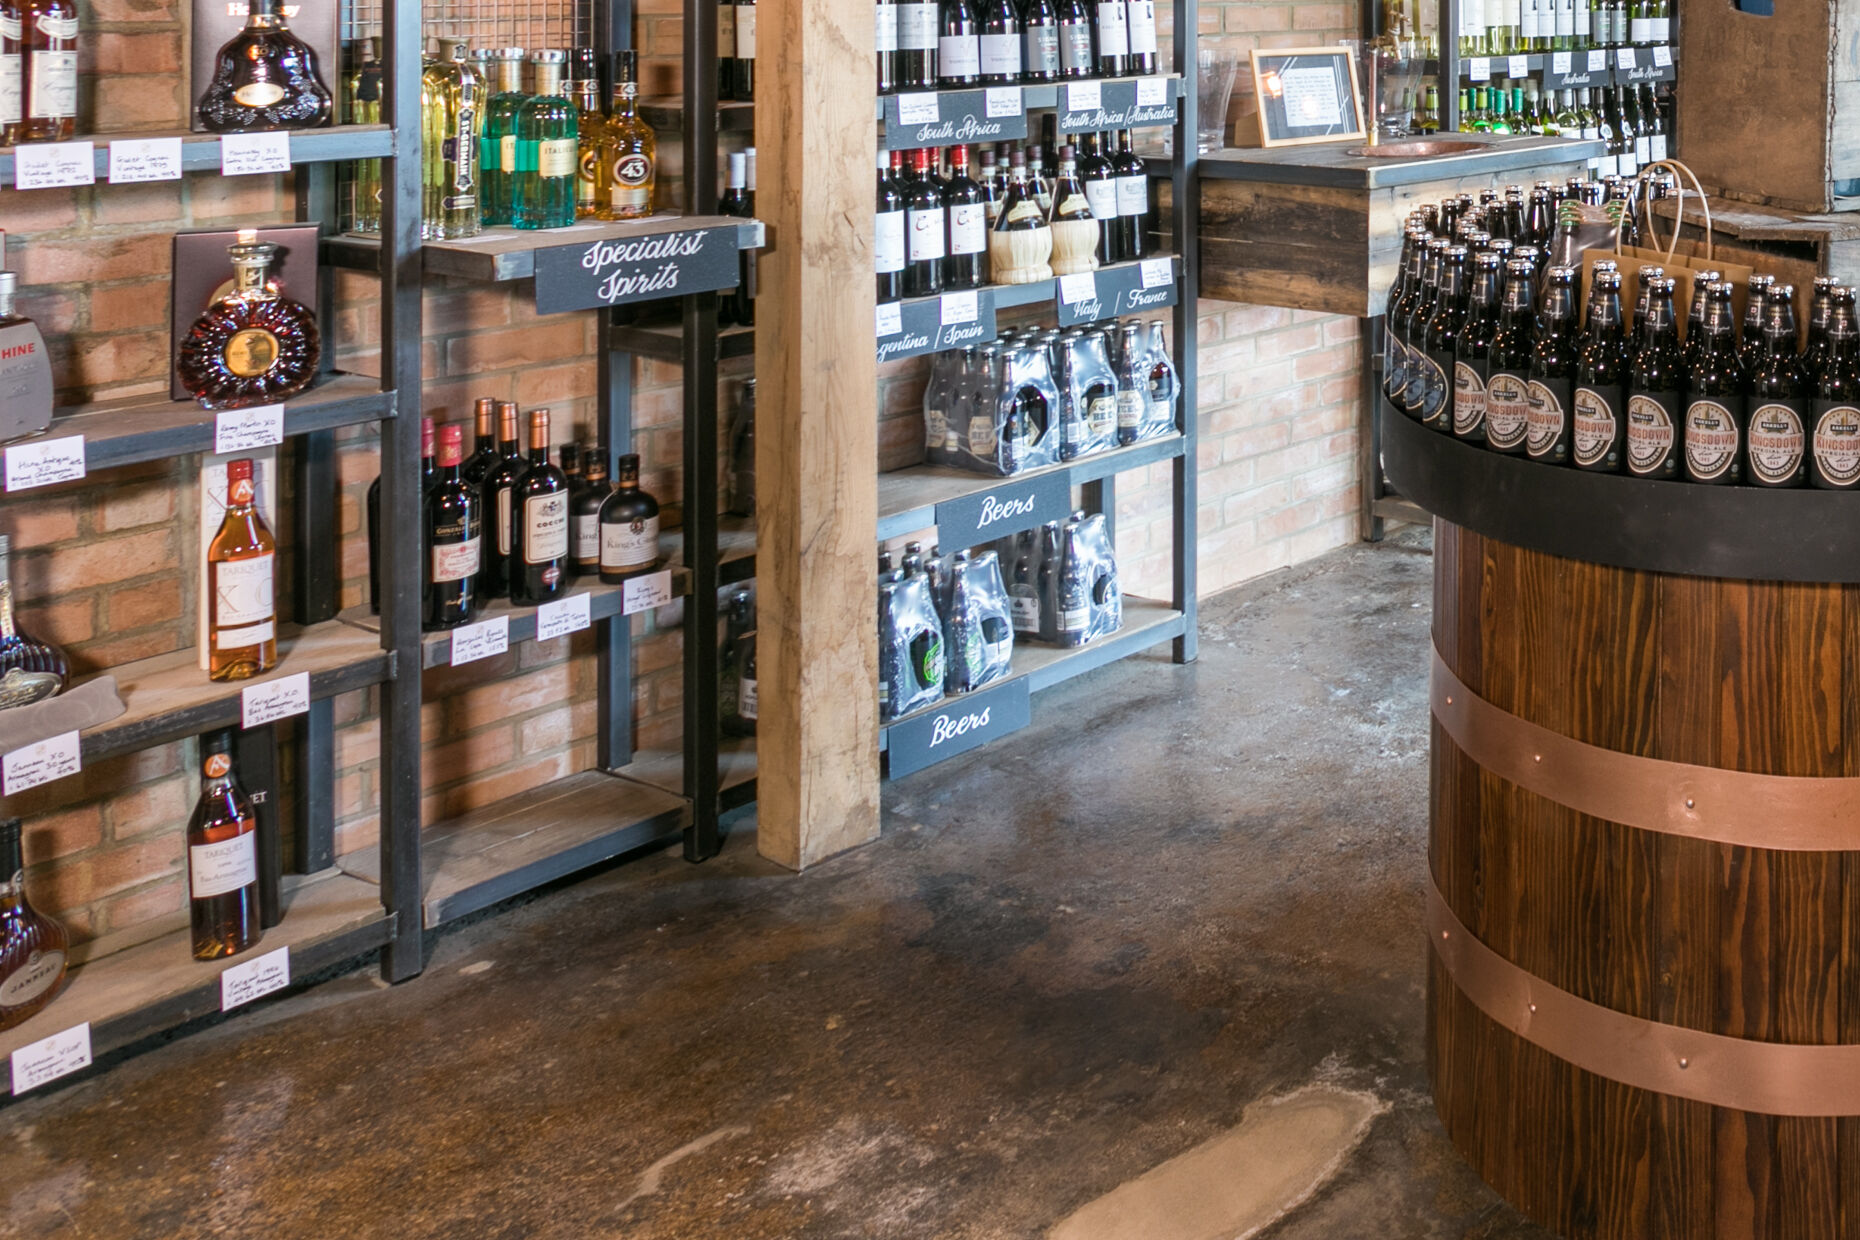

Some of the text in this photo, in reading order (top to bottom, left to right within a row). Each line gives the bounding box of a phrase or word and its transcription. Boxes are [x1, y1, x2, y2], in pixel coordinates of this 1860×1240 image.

[917, 113, 1001, 142] South Africa
[1061, 105, 1176, 129] South Africa Australia
[620, 160, 646, 178] 43
[582, 230, 709, 276] Specialist
[597, 261, 680, 304] Spirits
[1126, 288, 1168, 309] France
[1, 342, 36, 360] HINE
[876, 335, 929, 363] gentina
[943, 324, 985, 345] Spain
[1750, 433, 1802, 448] KINGSDOWN
[977, 494, 1035, 529] Beers
[929, 707, 991, 747] Beers
